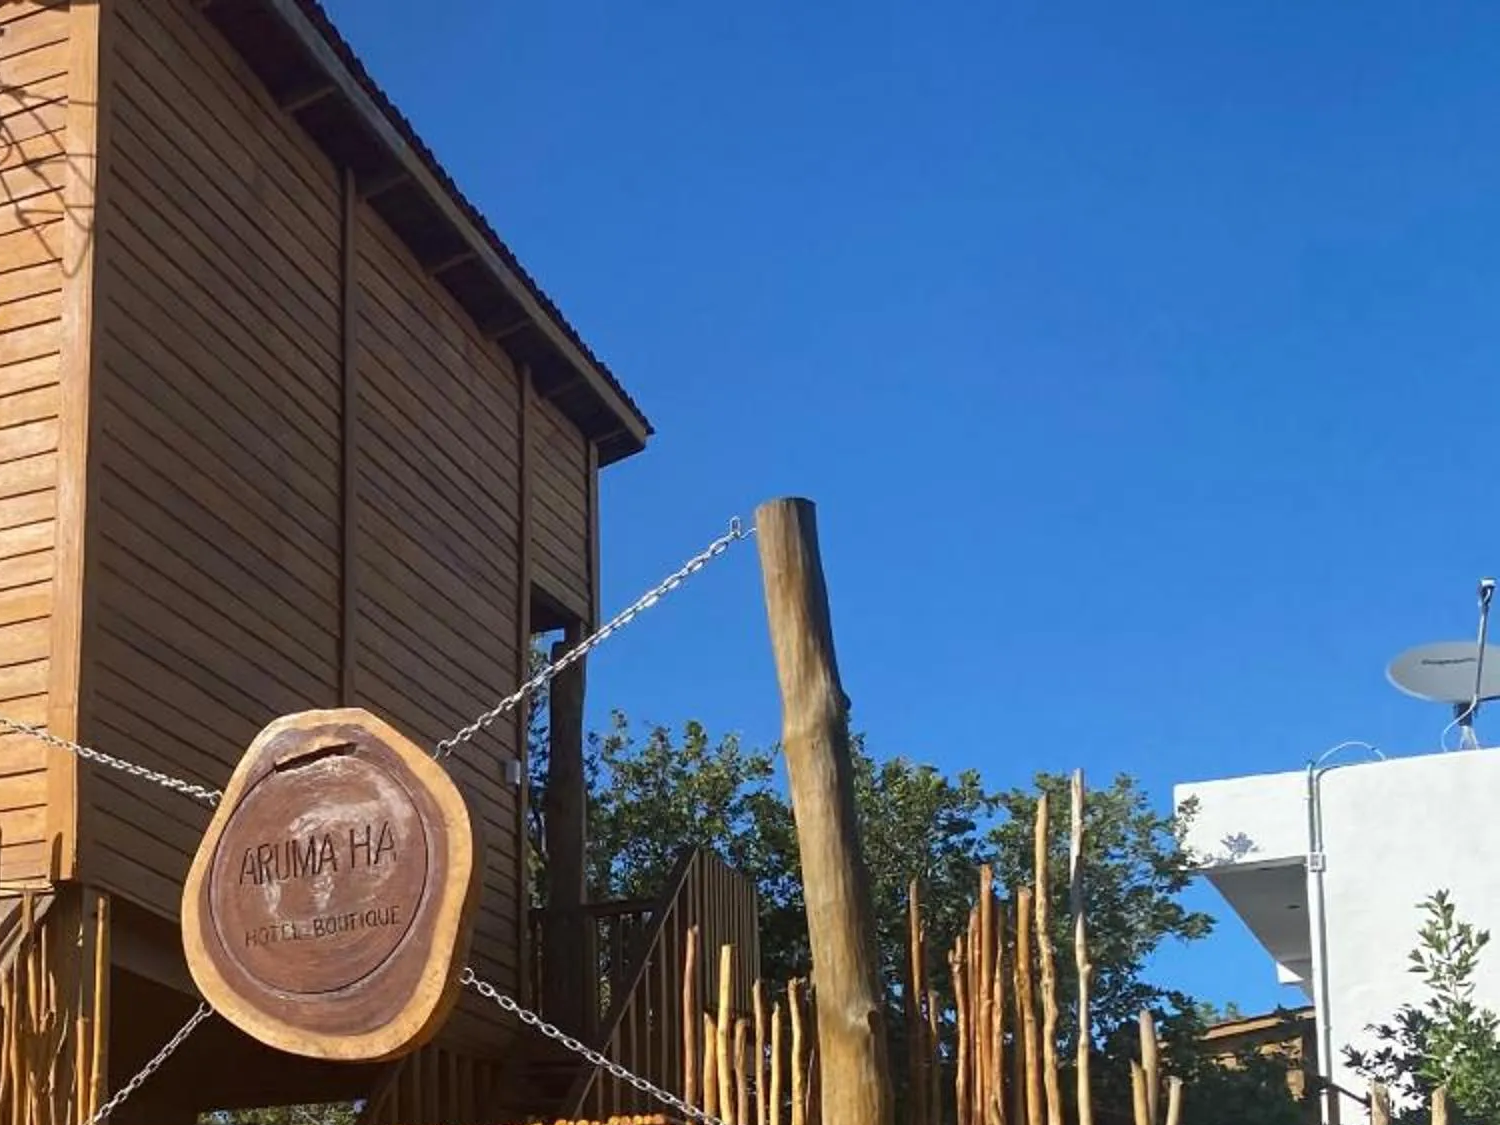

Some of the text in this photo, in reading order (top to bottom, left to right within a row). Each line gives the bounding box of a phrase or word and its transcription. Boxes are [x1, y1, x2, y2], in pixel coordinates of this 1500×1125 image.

[238, 820, 398, 886] ARUMA HA
[245, 905, 401, 948] HOTEL BOUTIQUE
